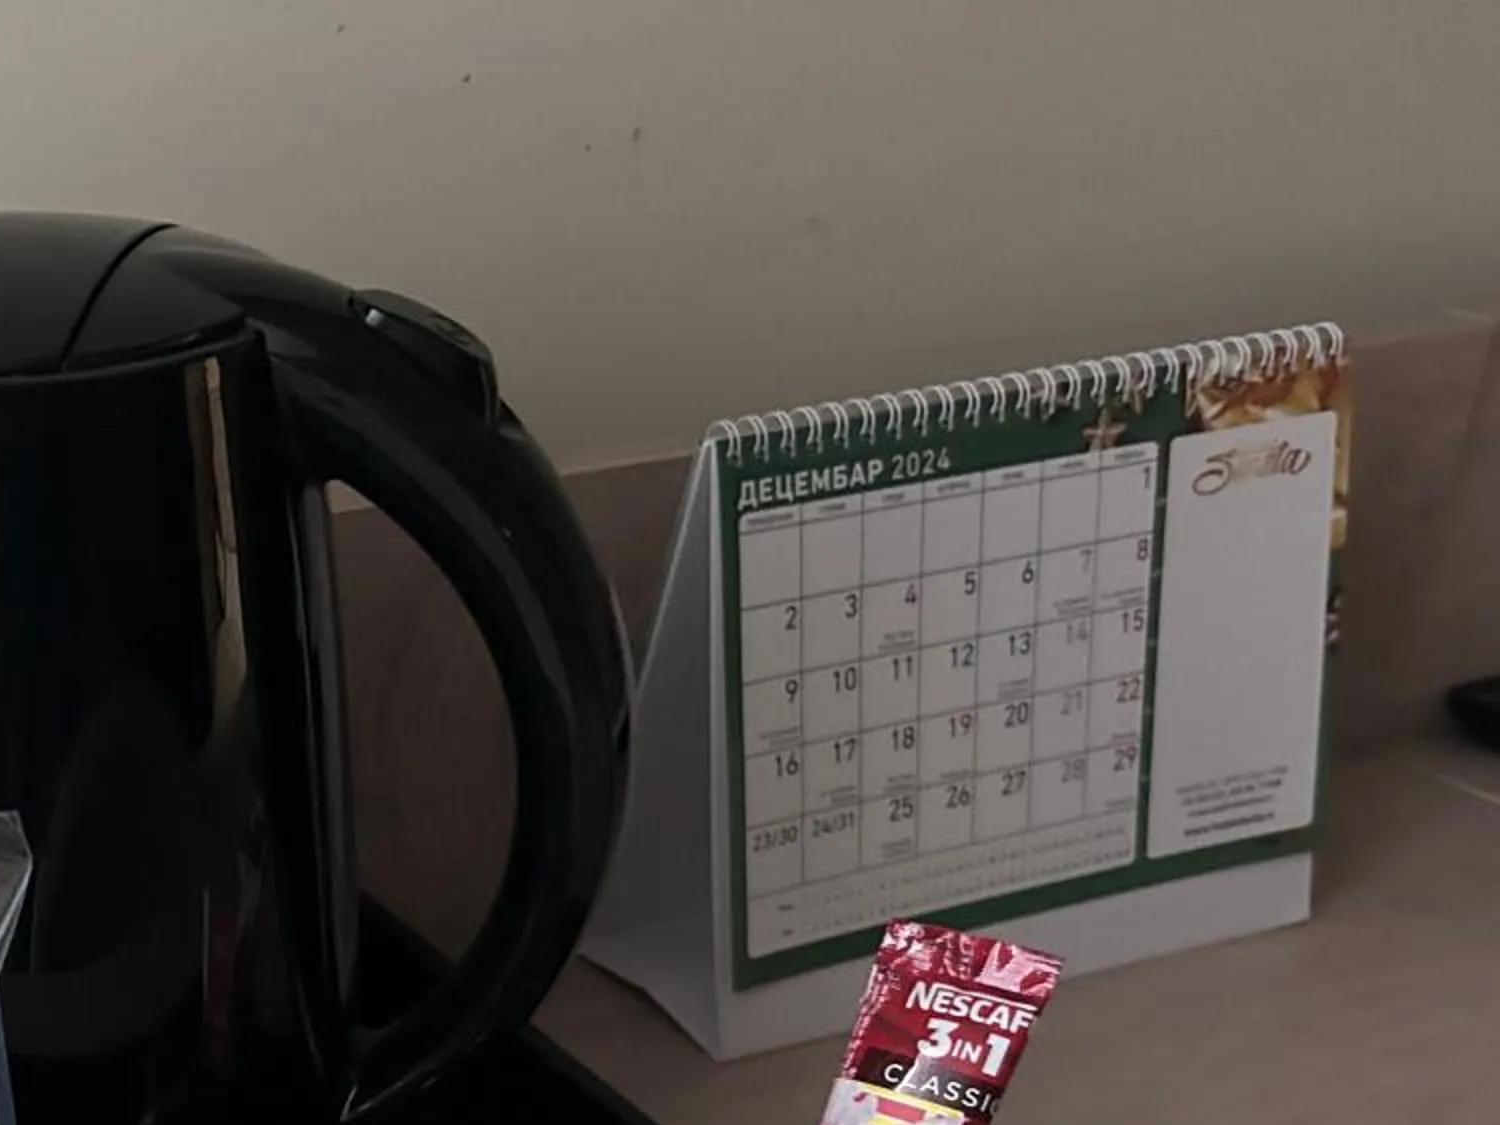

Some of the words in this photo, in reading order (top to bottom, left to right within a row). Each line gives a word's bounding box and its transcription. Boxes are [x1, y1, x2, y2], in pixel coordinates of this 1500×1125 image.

[737, 457, 883, 511] ДЕЦЕМБАР
[891, 447, 952, 481] 2024
[1142, 466, 1151, 489] 1
[784, 606, 798, 631] 2
[845, 594, 858, 619] 3
[904, 583, 917, 605] 4
[964, 571, 977, 595] 5
[1021, 560, 1034, 584] 6
[1080, 549, 1093, 573] 7
[1136, 538, 1149, 561] 8
[785, 679, 798, 703] 9
[833, 666, 857, 693] 10
[892, 655, 914, 680] 11
[951, 643, 975, 668] 12
[1008, 632, 1031, 656] 13
[1066, 620, 1088, 645] 14
[1121, 608, 1145, 634] 15
[775, 752, 799, 778] 16
[833, 738, 857, 763] 17
[891, 725, 915, 751] 18
[949, 713, 973, 738] 19
[1004, 702, 1029, 728] 20
[1060, 689, 1083, 716] 21
[1116, 677, 1141, 703] 22
[752, 825, 798, 853] 23/30
[889, 797, 914, 822] 25
[946, 784, 971, 809] 26
[1001, 770, 1026, 796] 27
[1061, 758, 1085, 783] 28
[1112, 745, 1137, 771] 29
[905, 980, 1038, 1034] NESCAF
[916, 1016, 961, 1058] 3
[951, 1037, 984, 1064] IN
[981, 1032, 1012, 1077] 1
